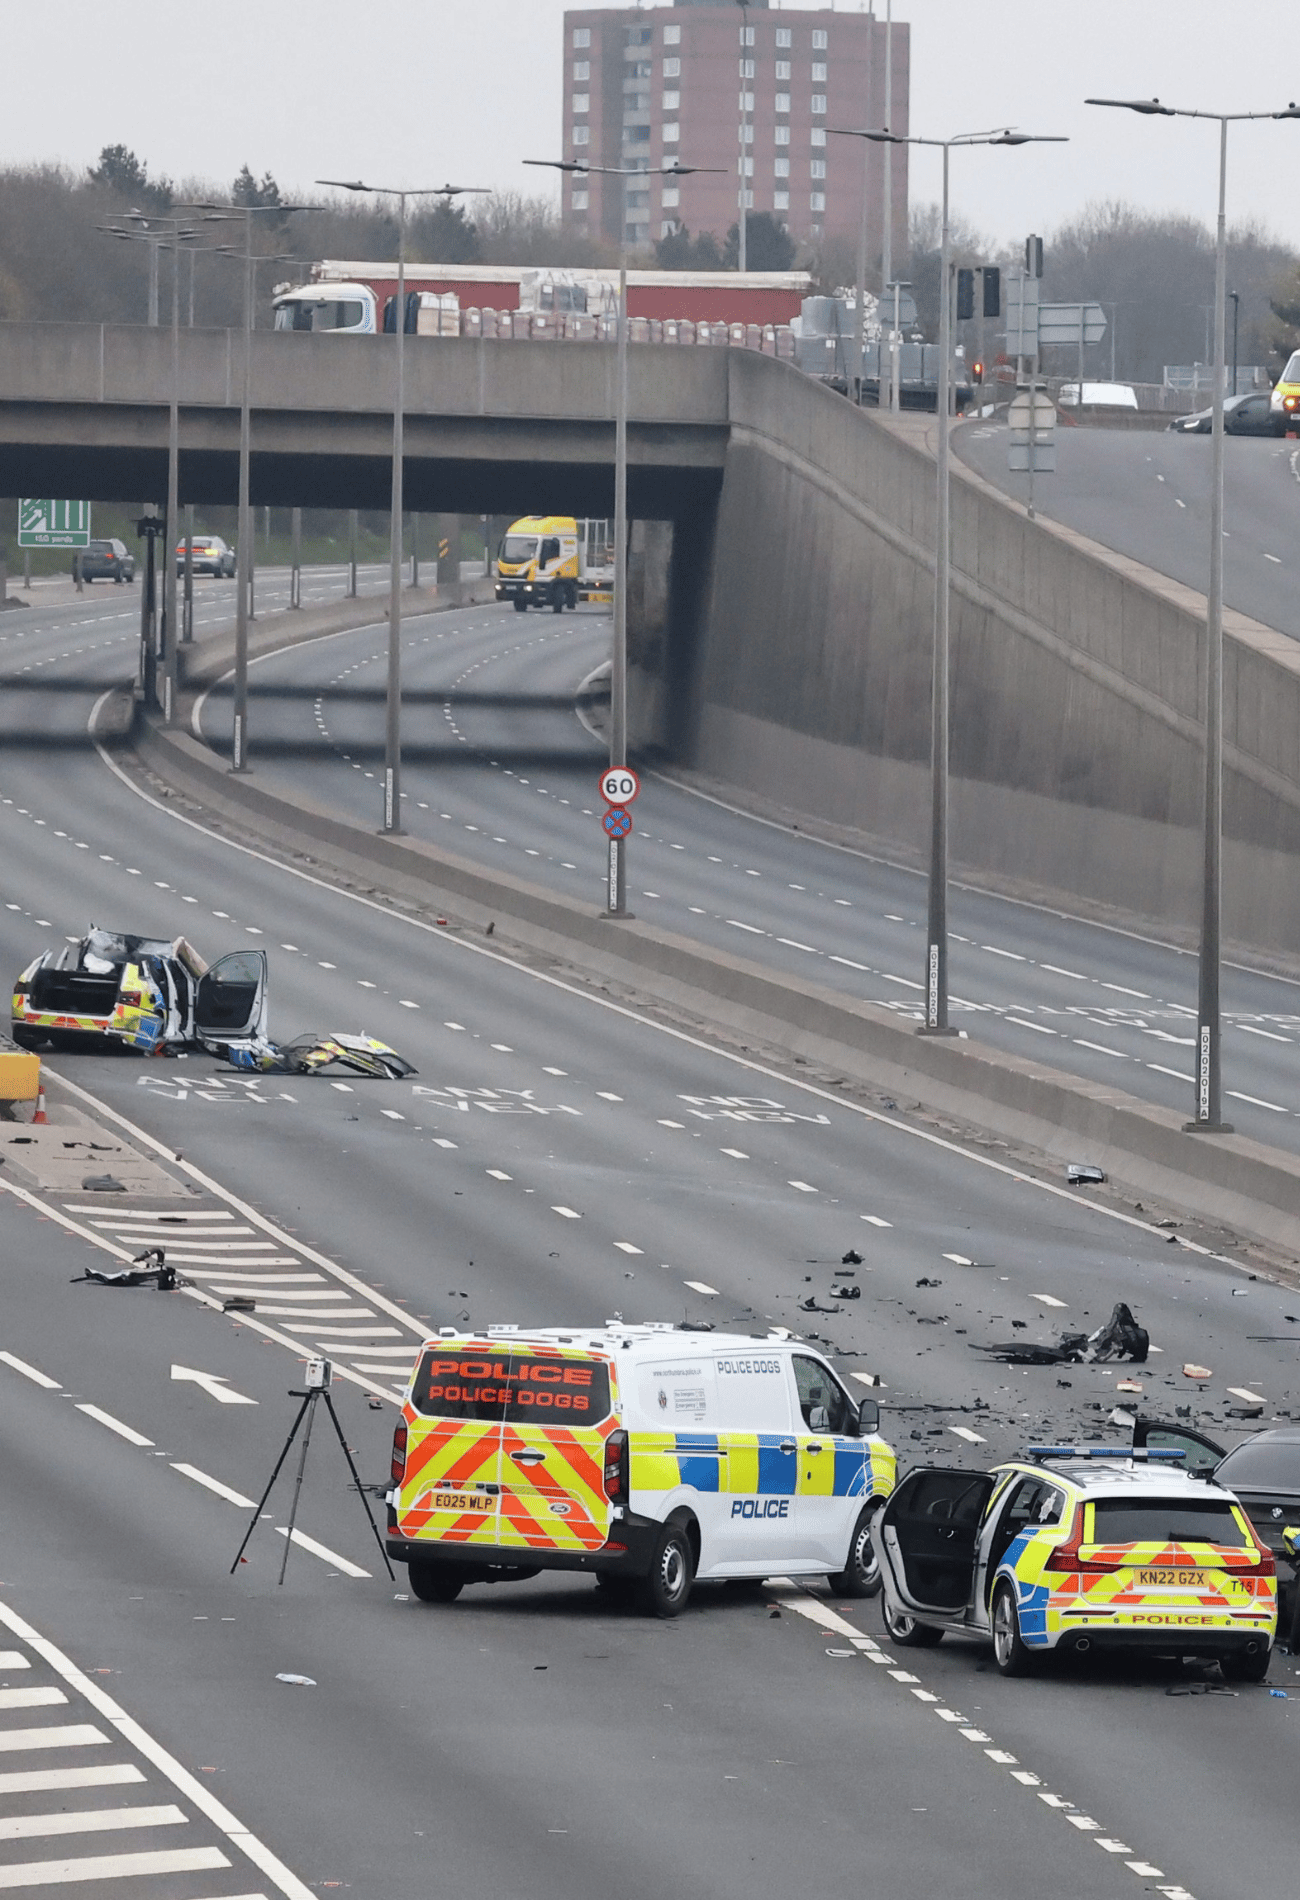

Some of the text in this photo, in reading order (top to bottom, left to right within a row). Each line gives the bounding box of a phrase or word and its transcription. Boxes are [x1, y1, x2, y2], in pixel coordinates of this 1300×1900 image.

[606, 779, 632, 794] 60
[136, 1076, 262, 1090] ANY
[147, 1089, 299, 1103] VEH
[412, 1085, 536, 1100] ANY
[426, 1099, 584, 1116] VEH
[676, 1094, 786, 1109] NO
[685, 1108, 832, 1125] HGV
[430, 1360, 594, 1386] POLICE
[717, 1361, 781, 1374] POLICE DOGS
[428, 1386, 591, 1411] POLICE DOGS
[469, 1496, 493, 1510] WLP
[731, 1500, 790, 1518] POLICE
[1140, 1571, 1205, 1585] KN22 GZX
[1132, 1615, 1214, 1625] POLICE
